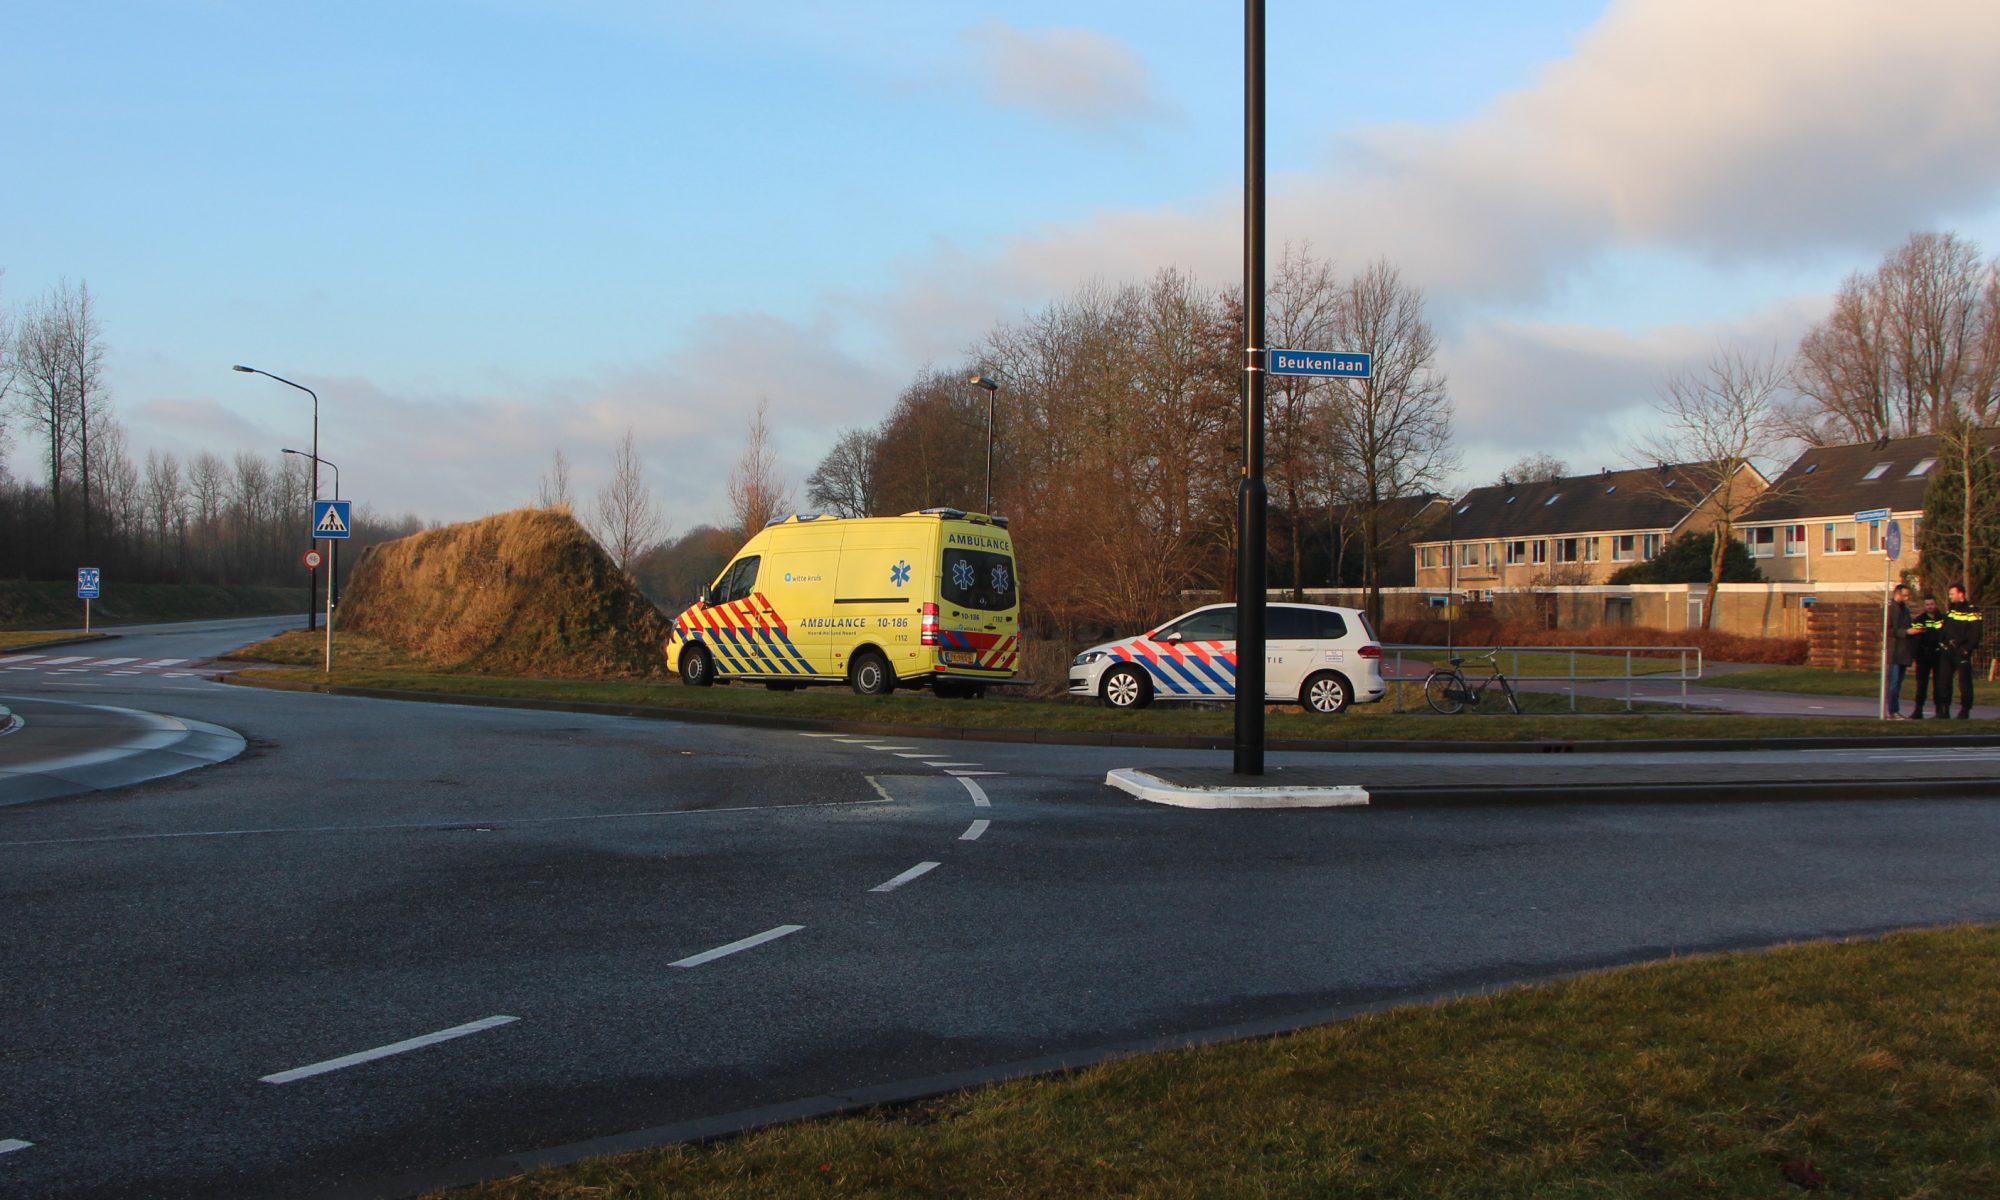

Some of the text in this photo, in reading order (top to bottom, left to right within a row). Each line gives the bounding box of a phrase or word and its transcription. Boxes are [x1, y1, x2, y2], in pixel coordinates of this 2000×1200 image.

[1278, 356, 1363, 371] Beukenlaan
[949, 533, 1009, 551] AMBULANCE
[800, 618, 908, 627] AMBULANCE 10-186
